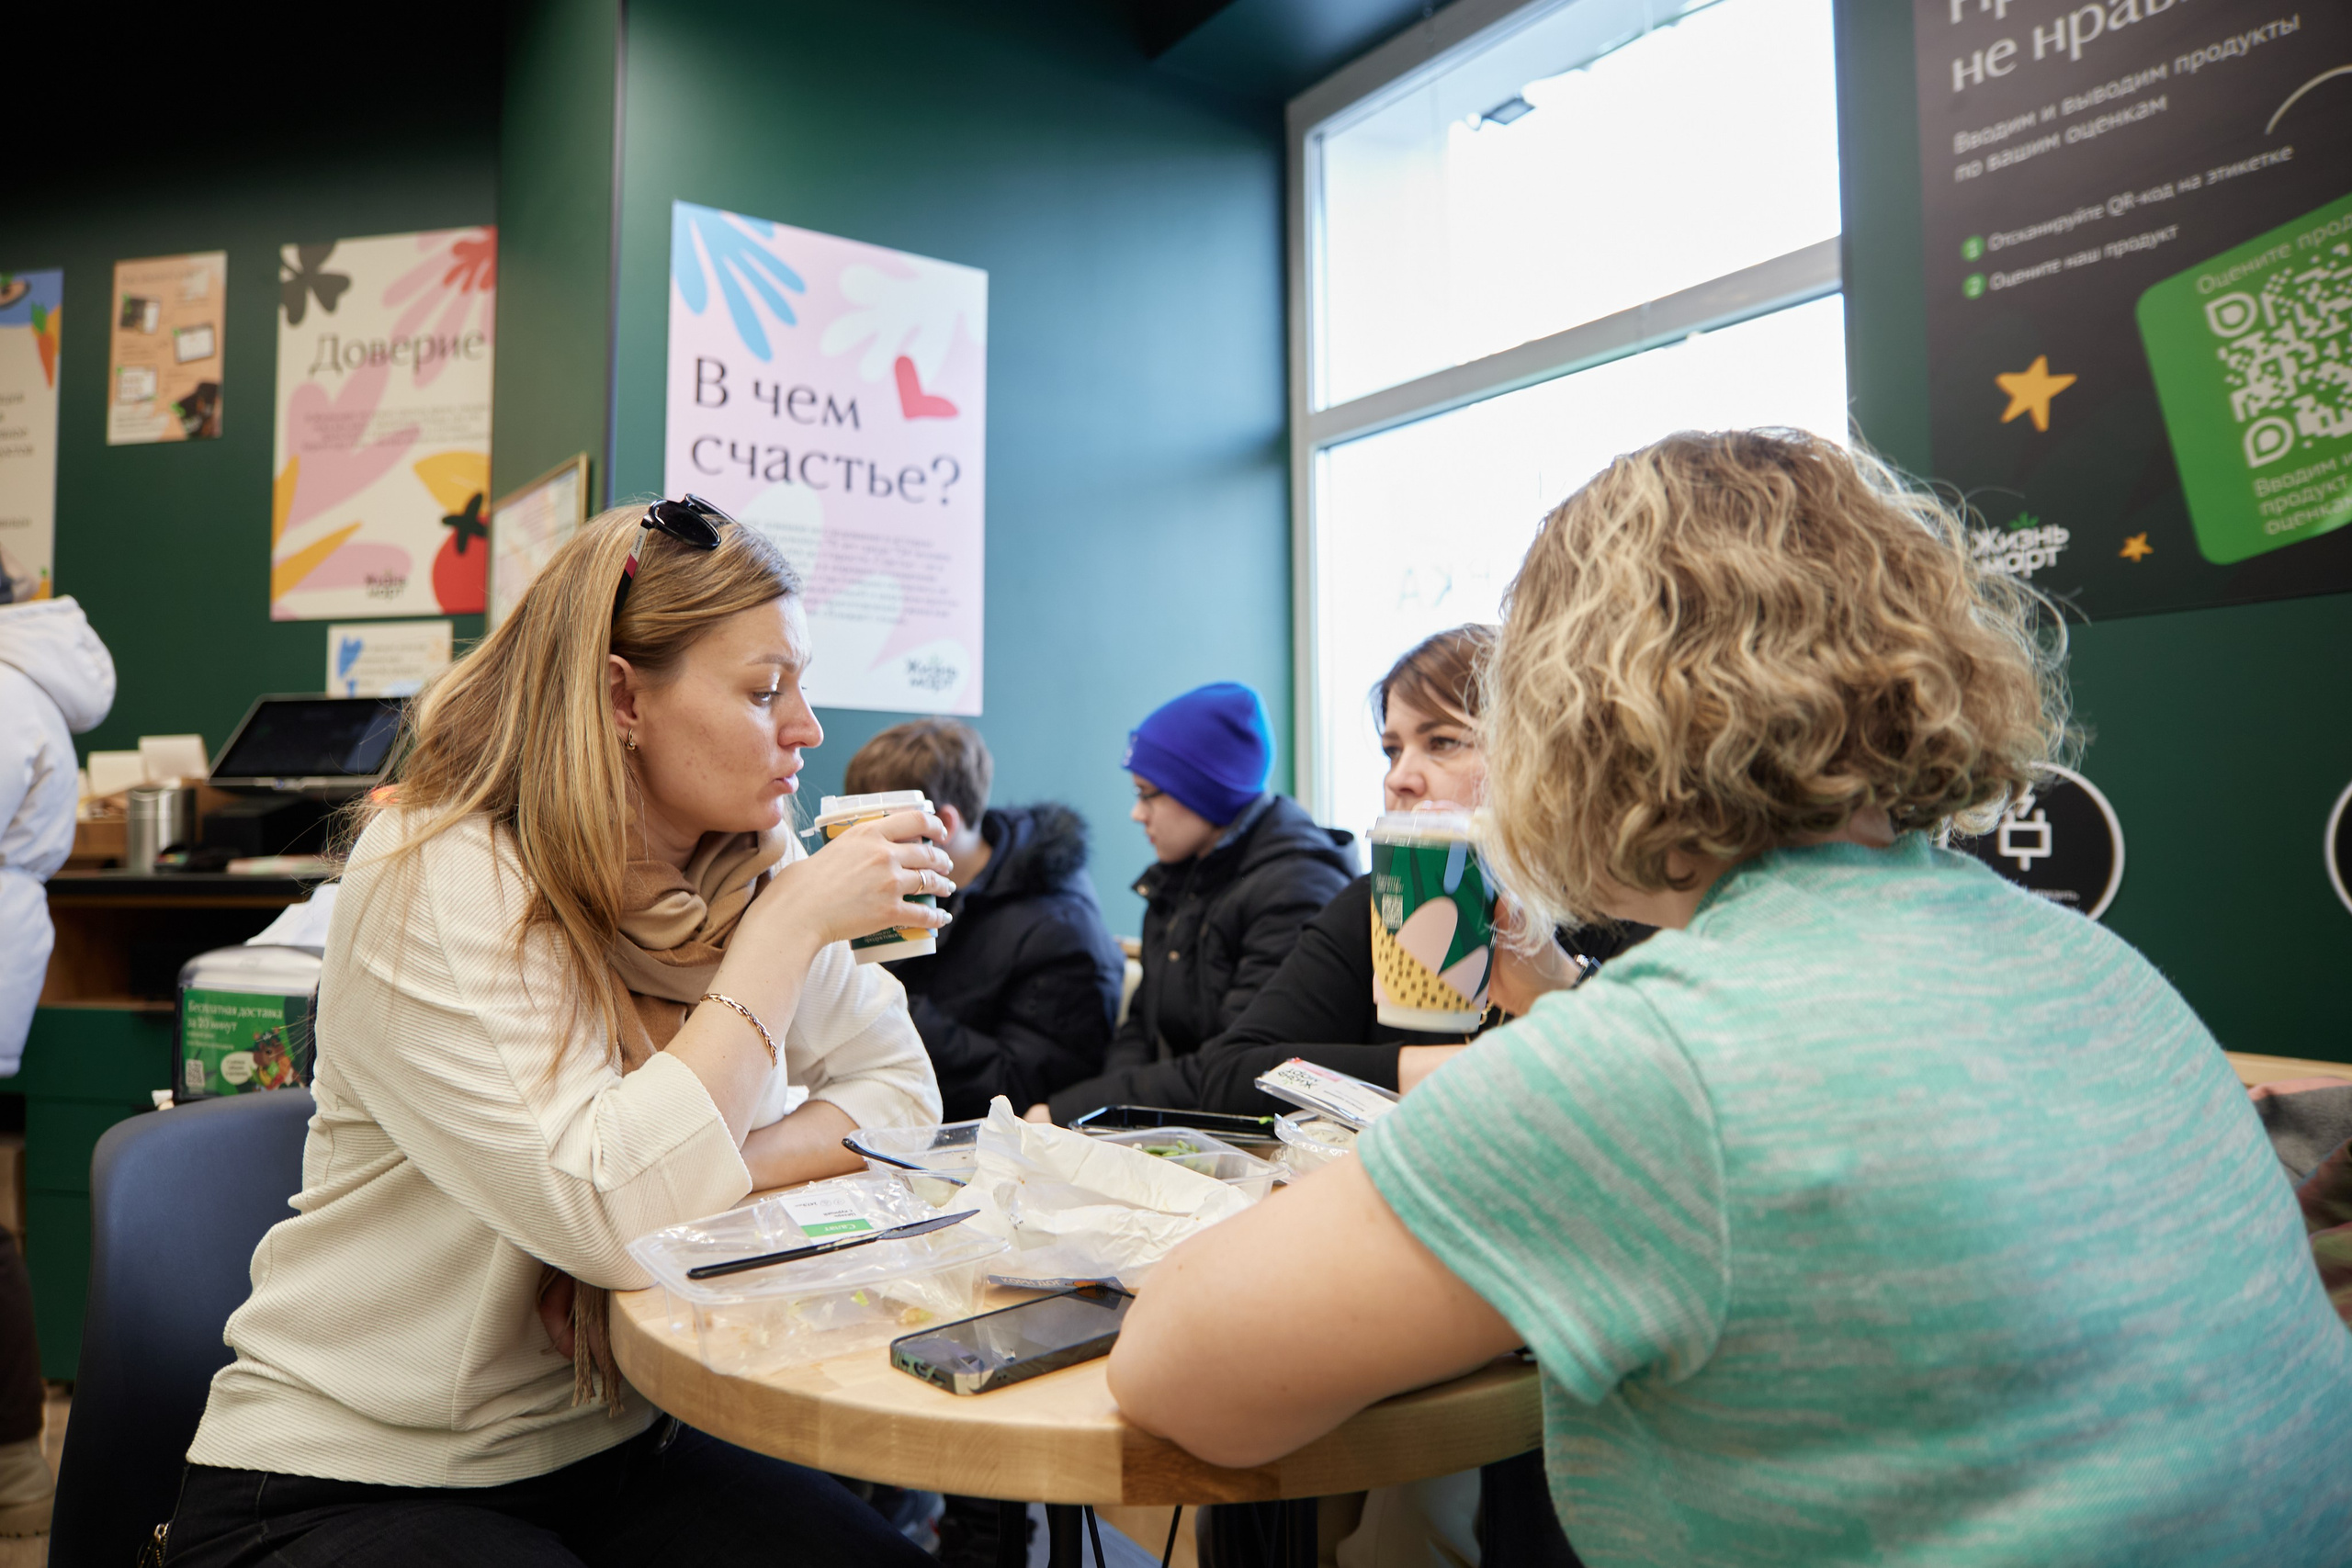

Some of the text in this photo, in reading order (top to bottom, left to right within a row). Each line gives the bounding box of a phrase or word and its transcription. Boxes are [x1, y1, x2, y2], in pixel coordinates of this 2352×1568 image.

[1951, 38, 2018, 93] не
[1953, 13, 2300, 155] Вводим и выводим продукты
[1954, 95, 2168, 184] по вашим оценкам
[1987, 145, 2294, 252] Отсканируйте QR-код на этикетке
[1989, 224, 2178, 291] Оцените наш продукт
[2197, 243, 2292, 295] Оцените
[308, 329, 486, 378] Доверие
[695, 356, 861, 430] В чем
[691, 434, 961, 506] счастье?
[2254, 458, 2337, 498] Вводим
[2259, 474, 2347, 516] продукт
[823, 1223, 856, 1232] Салат
